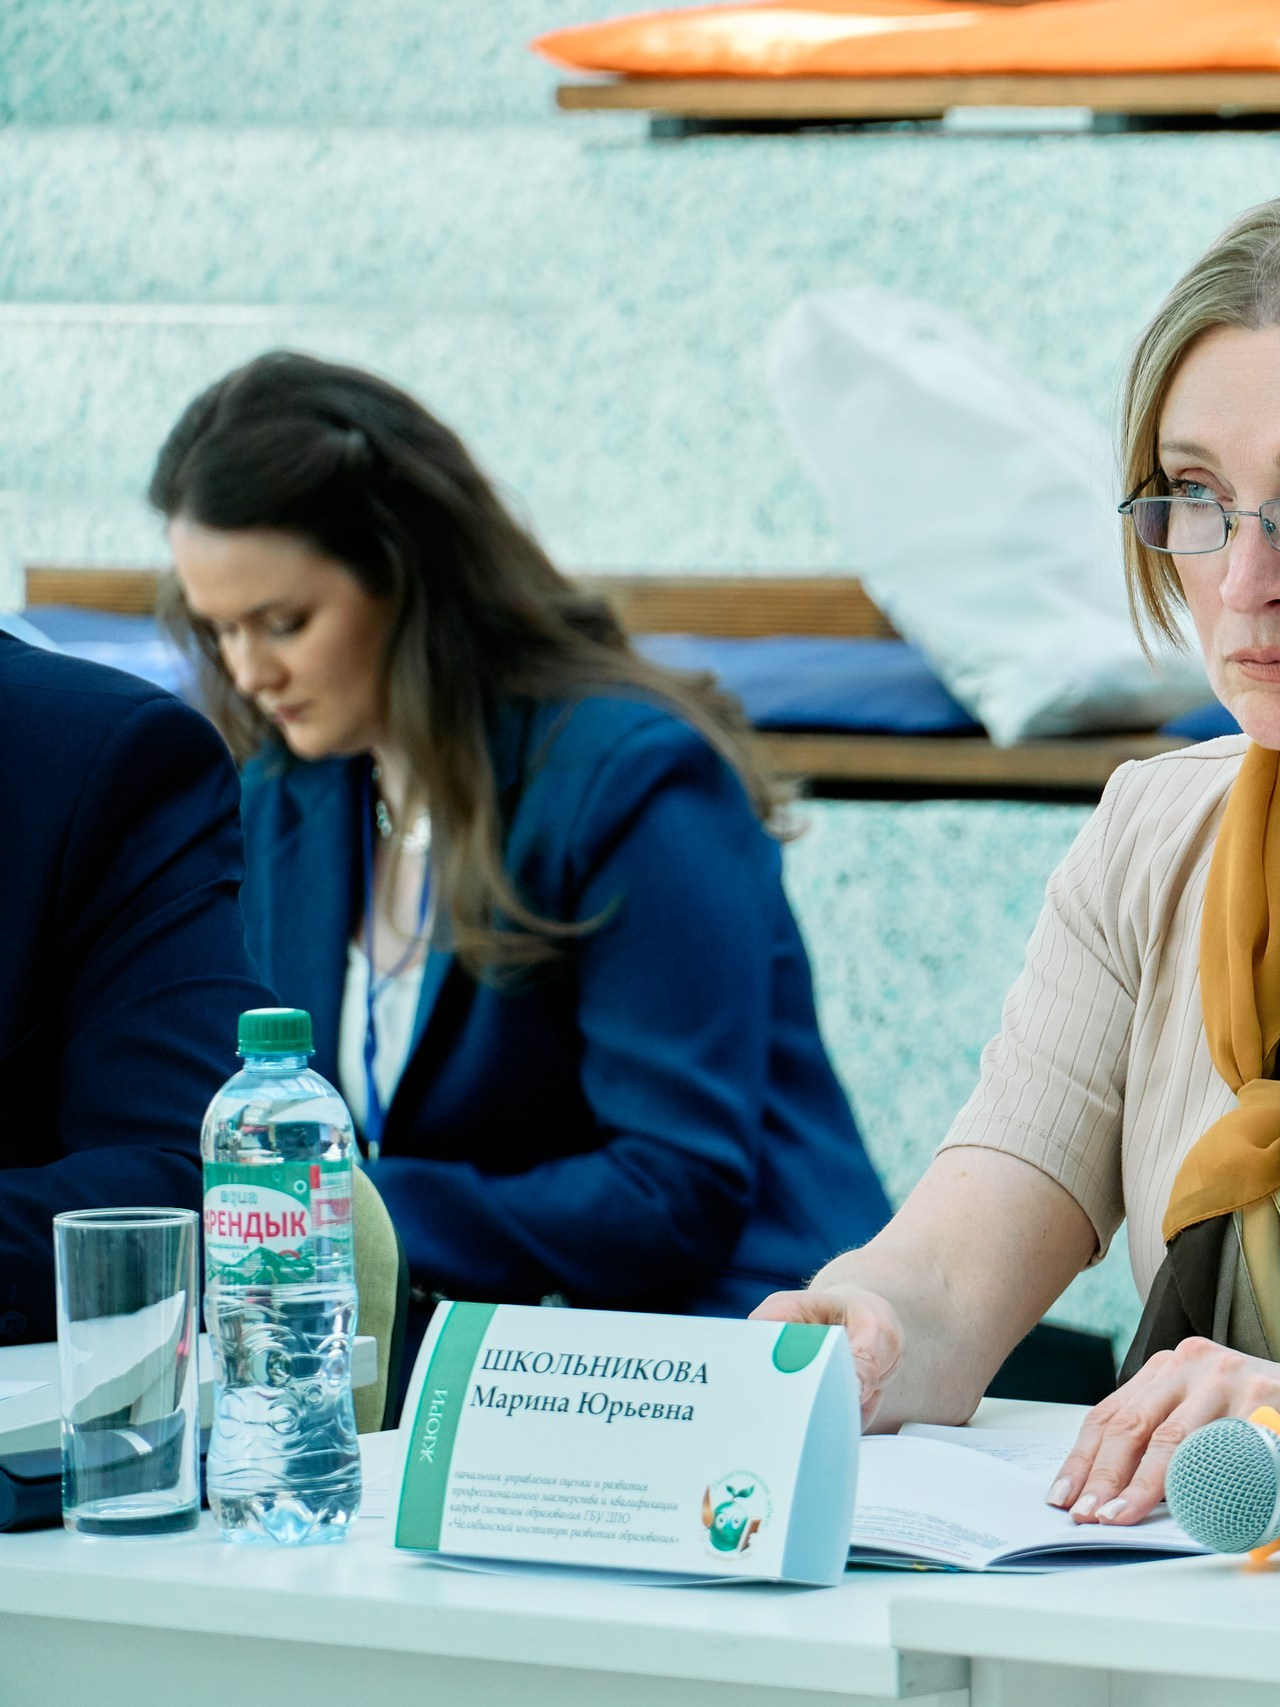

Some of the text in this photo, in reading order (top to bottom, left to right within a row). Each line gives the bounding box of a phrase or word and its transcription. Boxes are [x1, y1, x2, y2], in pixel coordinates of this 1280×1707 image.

[480, 1348, 709, 1384] ШКОЛЬНИКОВА
[469, 1384, 695, 1424] Марина Юрьевна
[419, 1389, 448, 1463] ЖЮРИ
[601, 1479, 649, 1492] развития
[583, 1509, 605, 1523] ГБУ
[604, 1511, 632, 1524] ДПО
